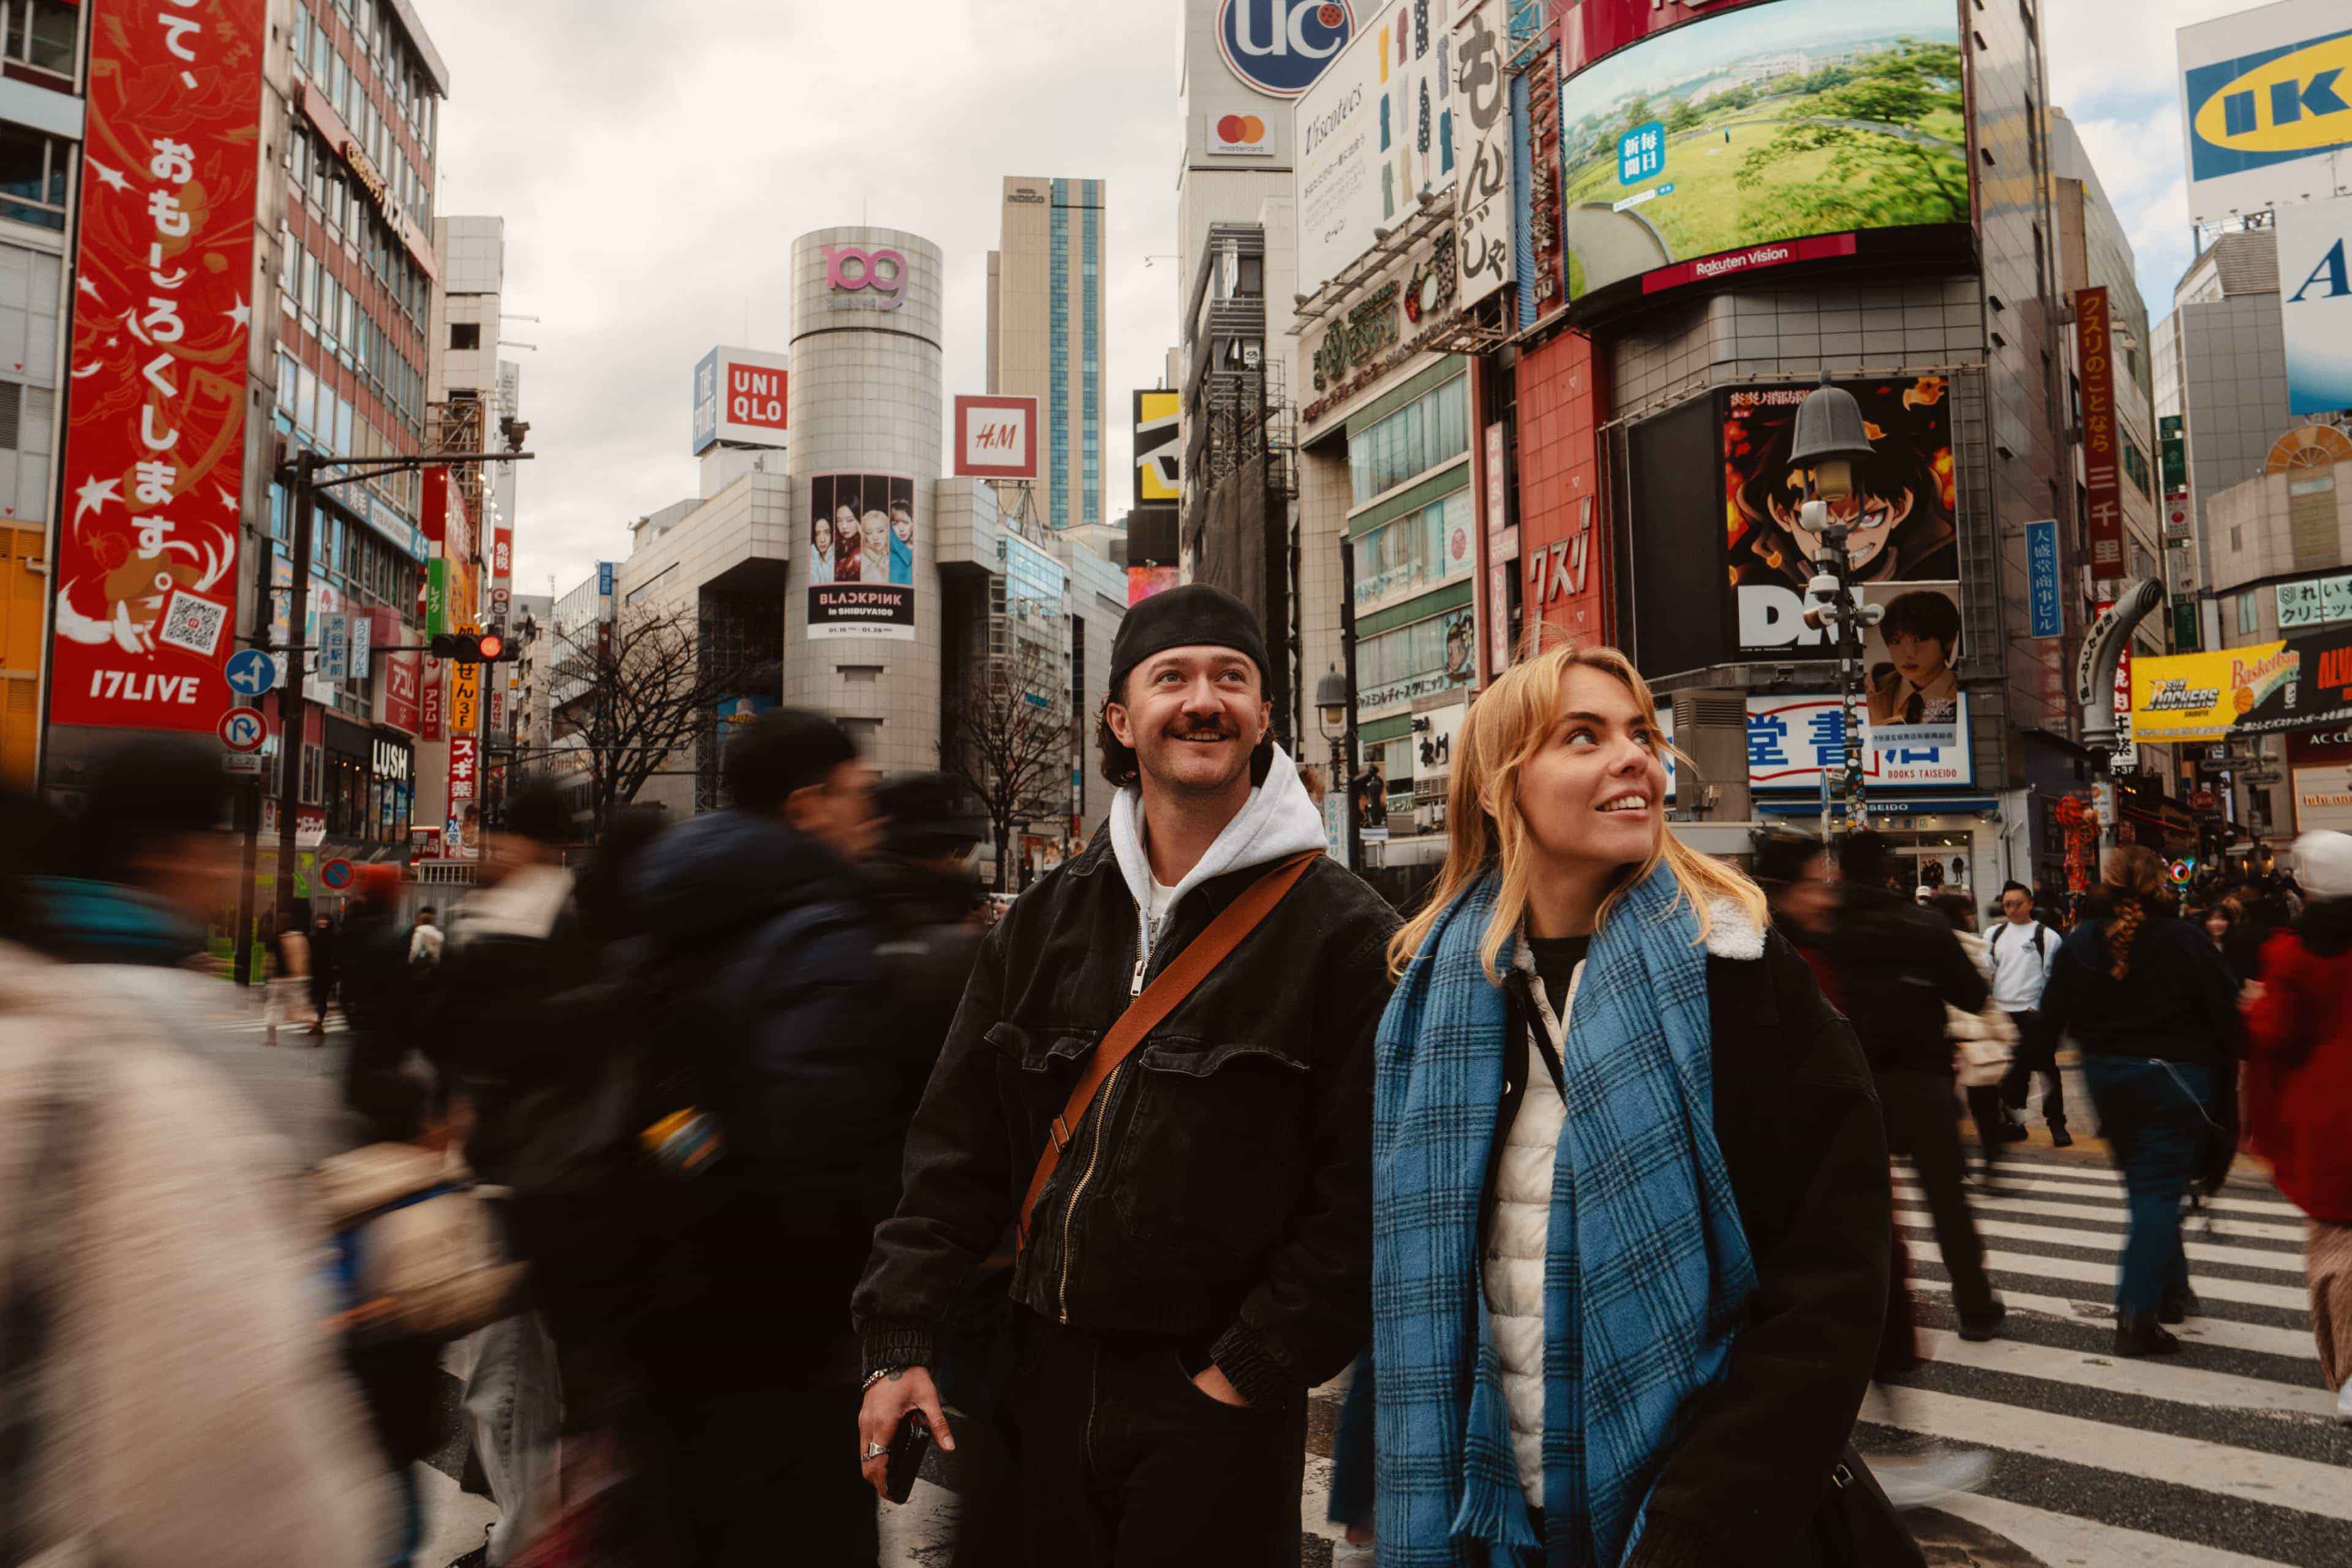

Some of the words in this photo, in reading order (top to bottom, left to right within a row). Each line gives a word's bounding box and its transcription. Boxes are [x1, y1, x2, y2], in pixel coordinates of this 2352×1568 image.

[1458, 13, 1506, 281] もんじゃ
[819, 244, 907, 310] 109
[1695, 255, 1747, 275] Rakuten
[1748, 247, 1789, 265] Vision
[130, 0, 202, 591] て、おもしろくします。
[734, 370, 778, 397] UNI
[2083, 295, 2109, 454] クスリのことなら
[734, 396, 782, 422] QLO
[976, 421, 1017, 450] H&M
[2089, 464, 2122, 565] 三千里
[496, 541, 509, 570] 免税
[1529, 529, 1589, 605] クスリ
[837, 607, 894, 617] SHIBUYA109
[2281, 605, 2352, 624] クリニッ
[392, 664, 415, 699] アコム
[425, 688, 439, 723] アコム
[372, 739, 408, 780] LUSH
[1888, 769, 1915, 779] BOOKS
[1920, 768, 1957, 778] TAISEIDO
[1866, 803, 1909, 812] ISEIDO
